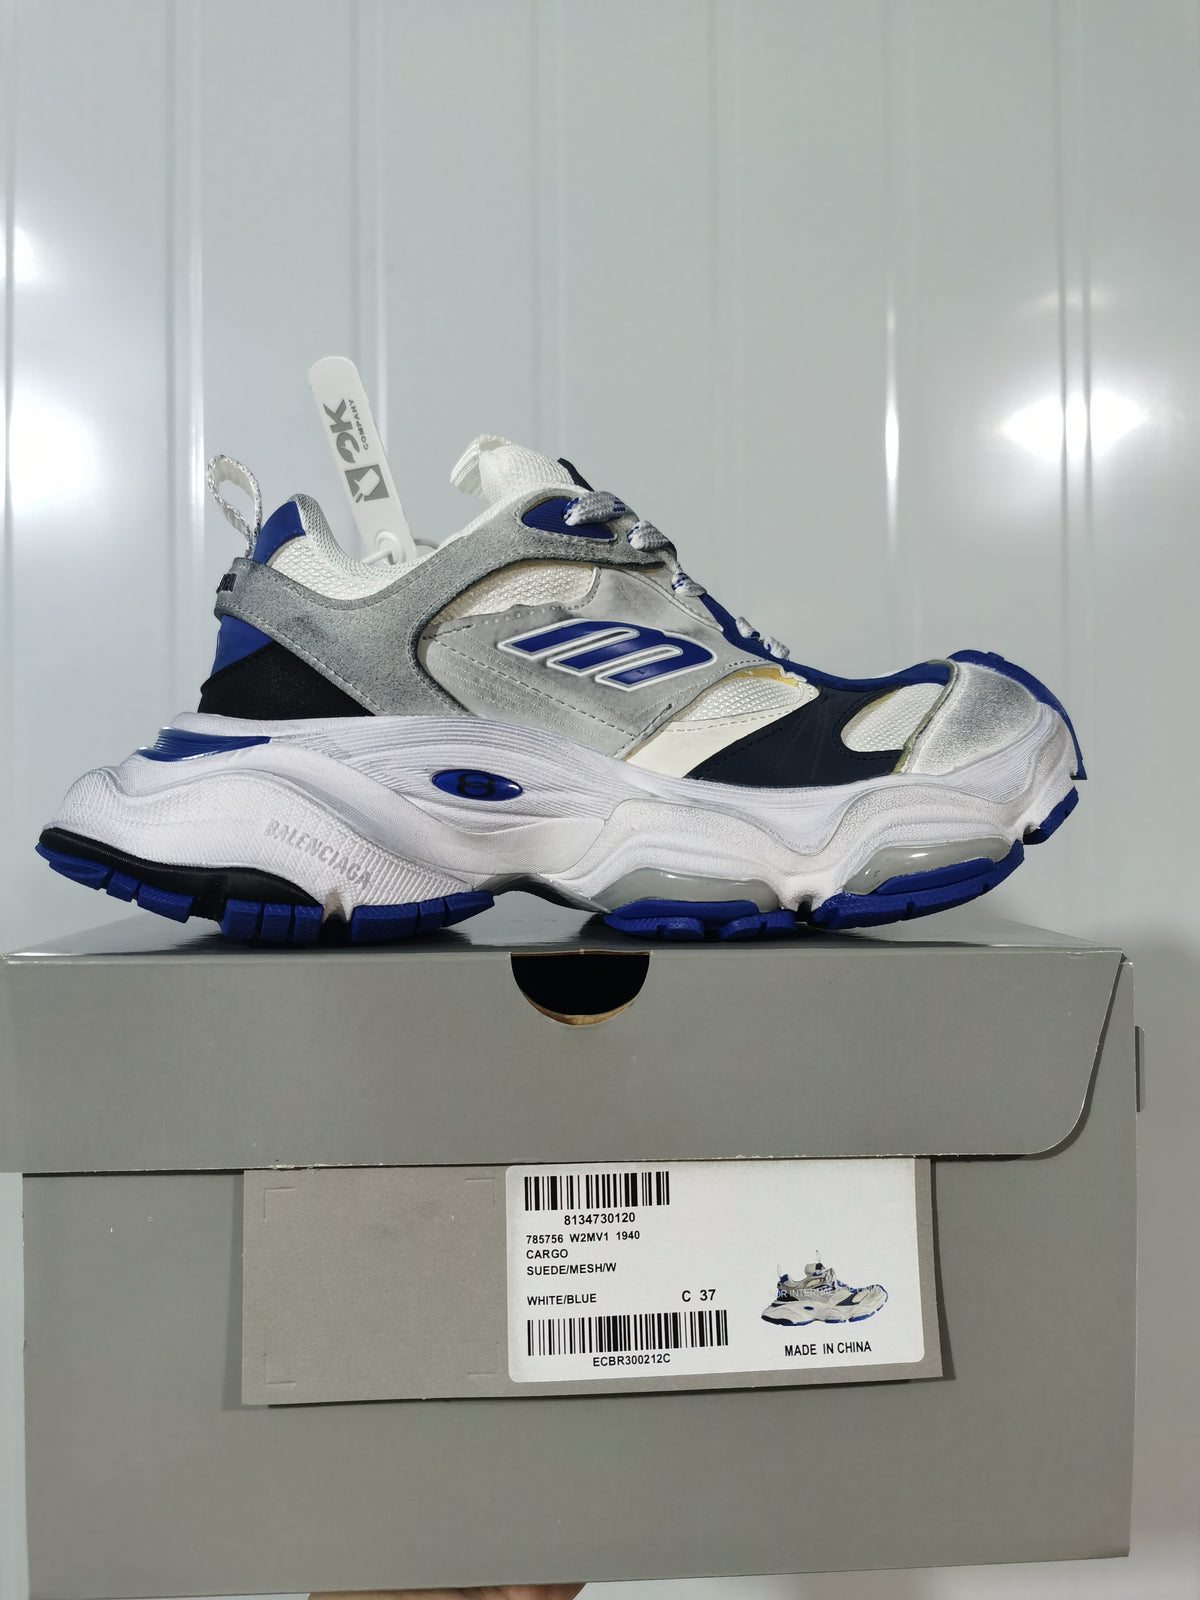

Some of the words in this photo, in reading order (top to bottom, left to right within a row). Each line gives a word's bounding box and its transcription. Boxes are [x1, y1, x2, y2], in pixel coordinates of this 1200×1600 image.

[348, 399, 369, 450] COMPANY
[264, 820, 371, 889] BALENCIAGA
[563, 1212, 636, 1226] 8134730120
[526, 1234, 564, 1245] 785756
[569, 1232, 609, 1243] W2MV1
[616, 1230, 641, 1241] 1940
[526, 1248, 569, 1260] CARGO
[526, 1262, 617, 1276] SUEDE/MESH/W
[527, 1293, 598, 1306] WHITE/BLUE
[681, 1290, 692, 1303] C
[699, 1288, 717, 1302] 37
[784, 1344, 817, 1357] MADE
[822, 1342, 834, 1355] IN
[837, 1340, 873, 1354] CHINA
[592, 1353, 672, 1367] ECBR300212C
